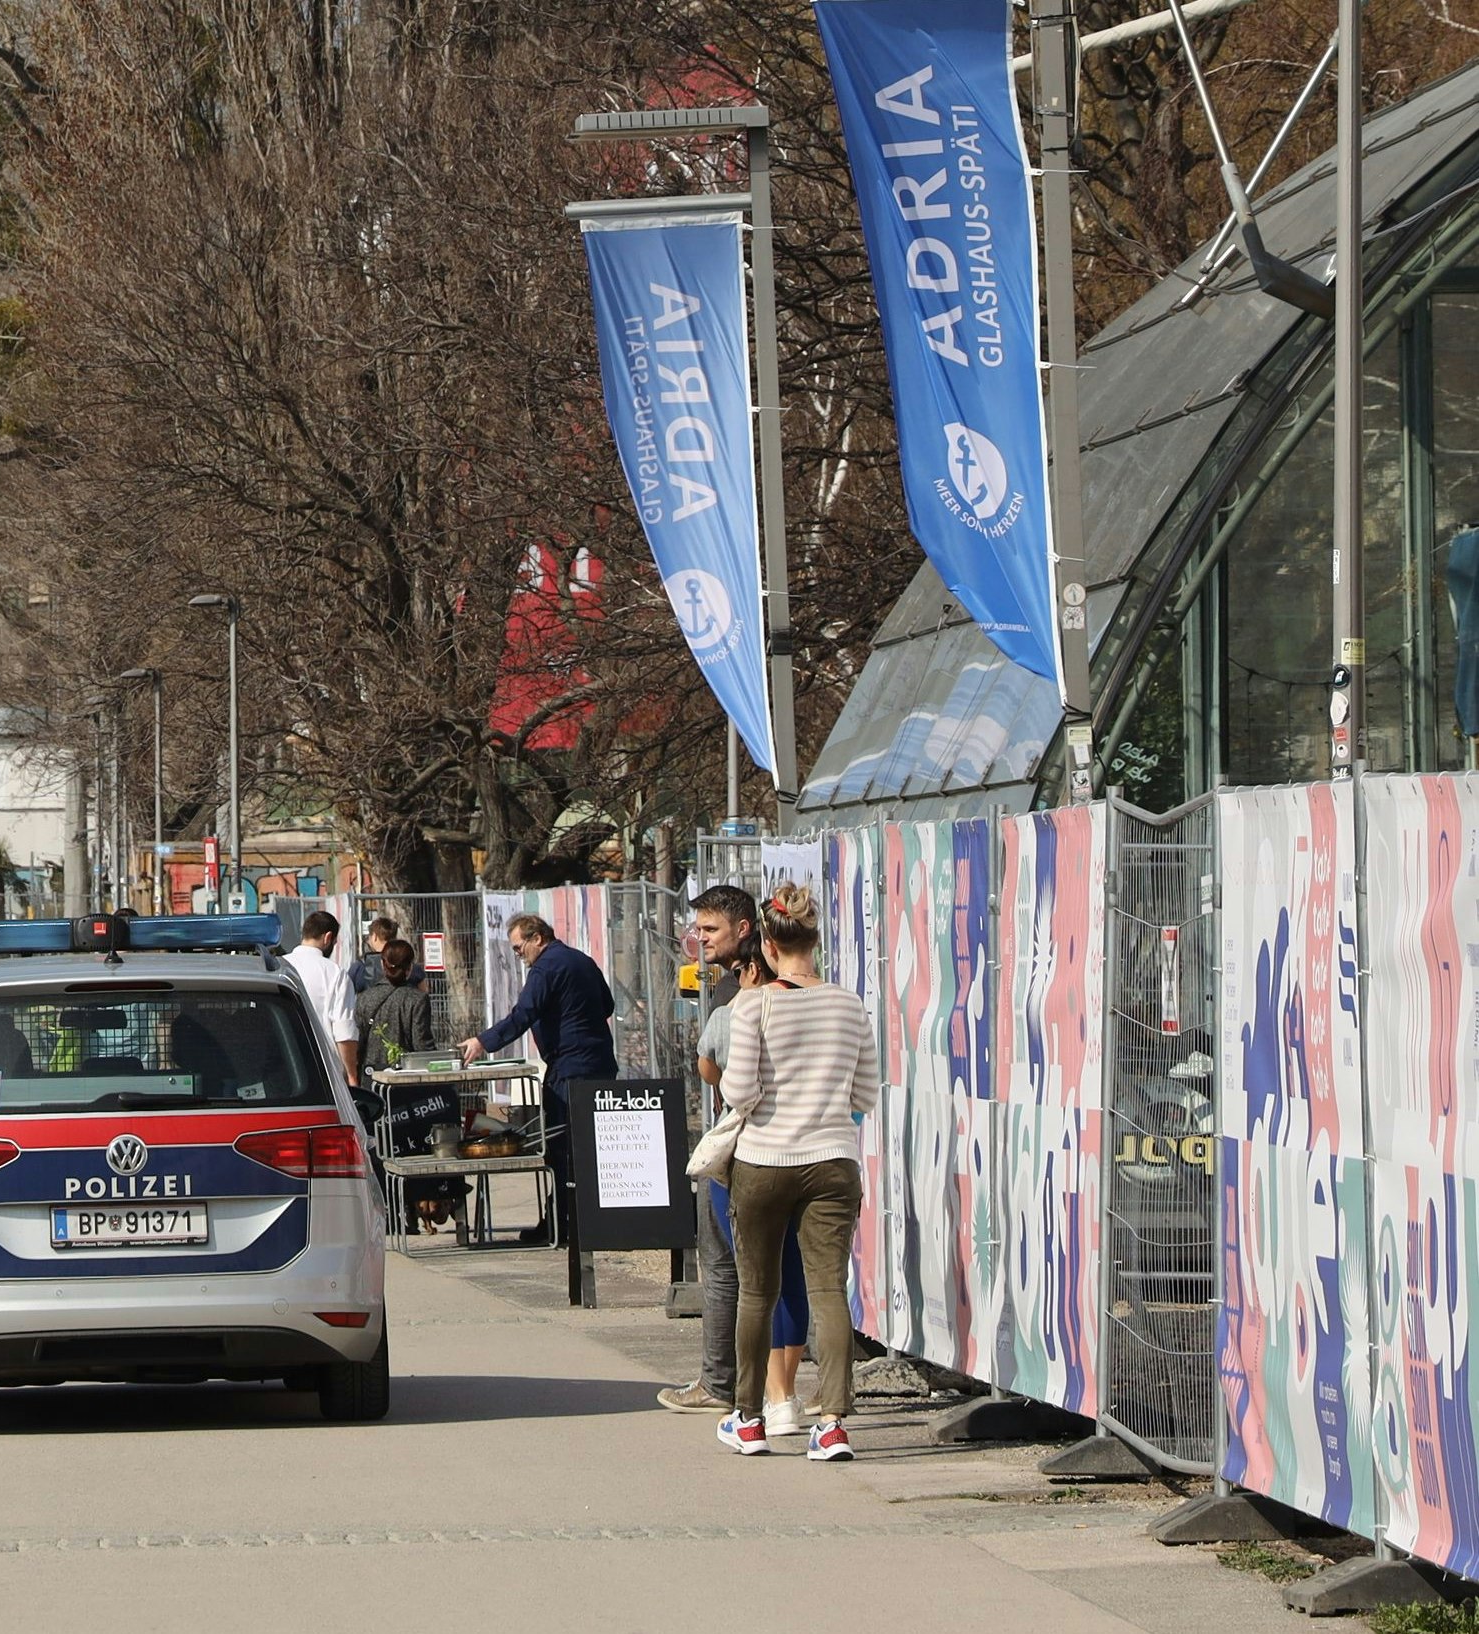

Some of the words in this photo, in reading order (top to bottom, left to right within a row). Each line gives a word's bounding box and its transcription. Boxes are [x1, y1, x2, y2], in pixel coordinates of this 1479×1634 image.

[875, 64, 969, 368] ADRIA
[950, 104, 1004, 368] GLASHAUS-SPÄTI
[933, 478, 961, 515] MEER
[989, 491, 1025, 538] HERZEN
[65, 1174, 192, 1199] POLIZEI
[600, 1172, 623, 1180] LIMO
[78, 1212, 107, 1236] BP
[125, 1210, 192, 1234] 91371
